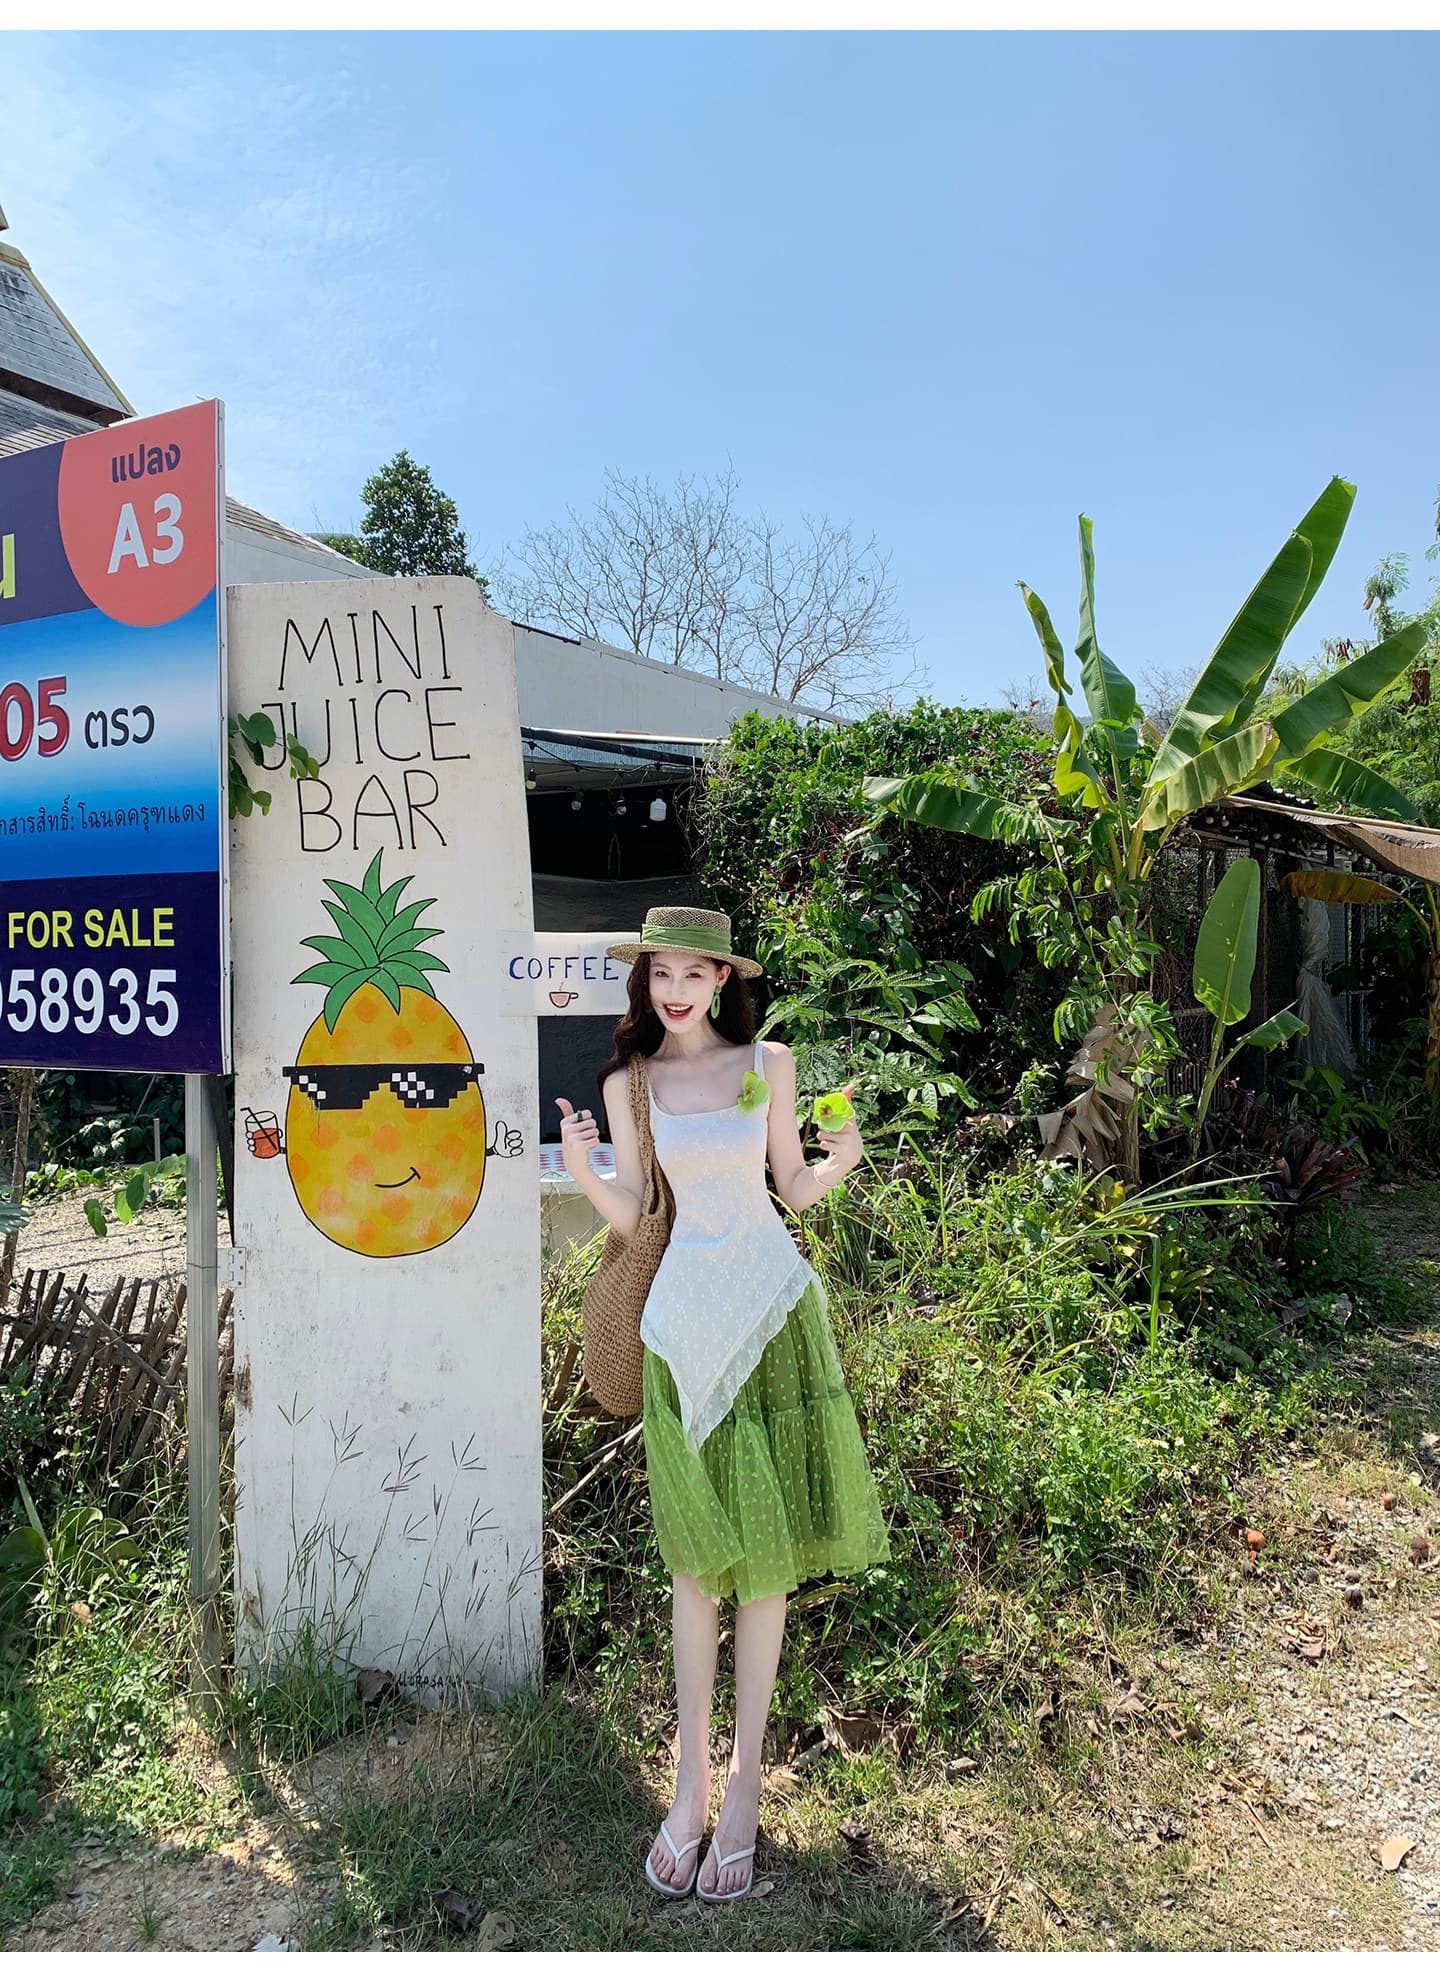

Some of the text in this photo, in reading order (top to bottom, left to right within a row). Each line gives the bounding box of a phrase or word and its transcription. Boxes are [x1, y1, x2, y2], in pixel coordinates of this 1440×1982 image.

[111, 443, 181, 483] แปลง
[107, 493, 184, 574] A3
[278, 605, 451, 691] MINI
[85, 705, 155, 749] ตรว
[261, 686, 470, 770] JUICE
[297, 769, 448, 852] BAR
[8, 907, 175, 949] FOR SALE
[0, 967, 179, 1037] 58935
[509, 956, 619, 981] COFFEE
